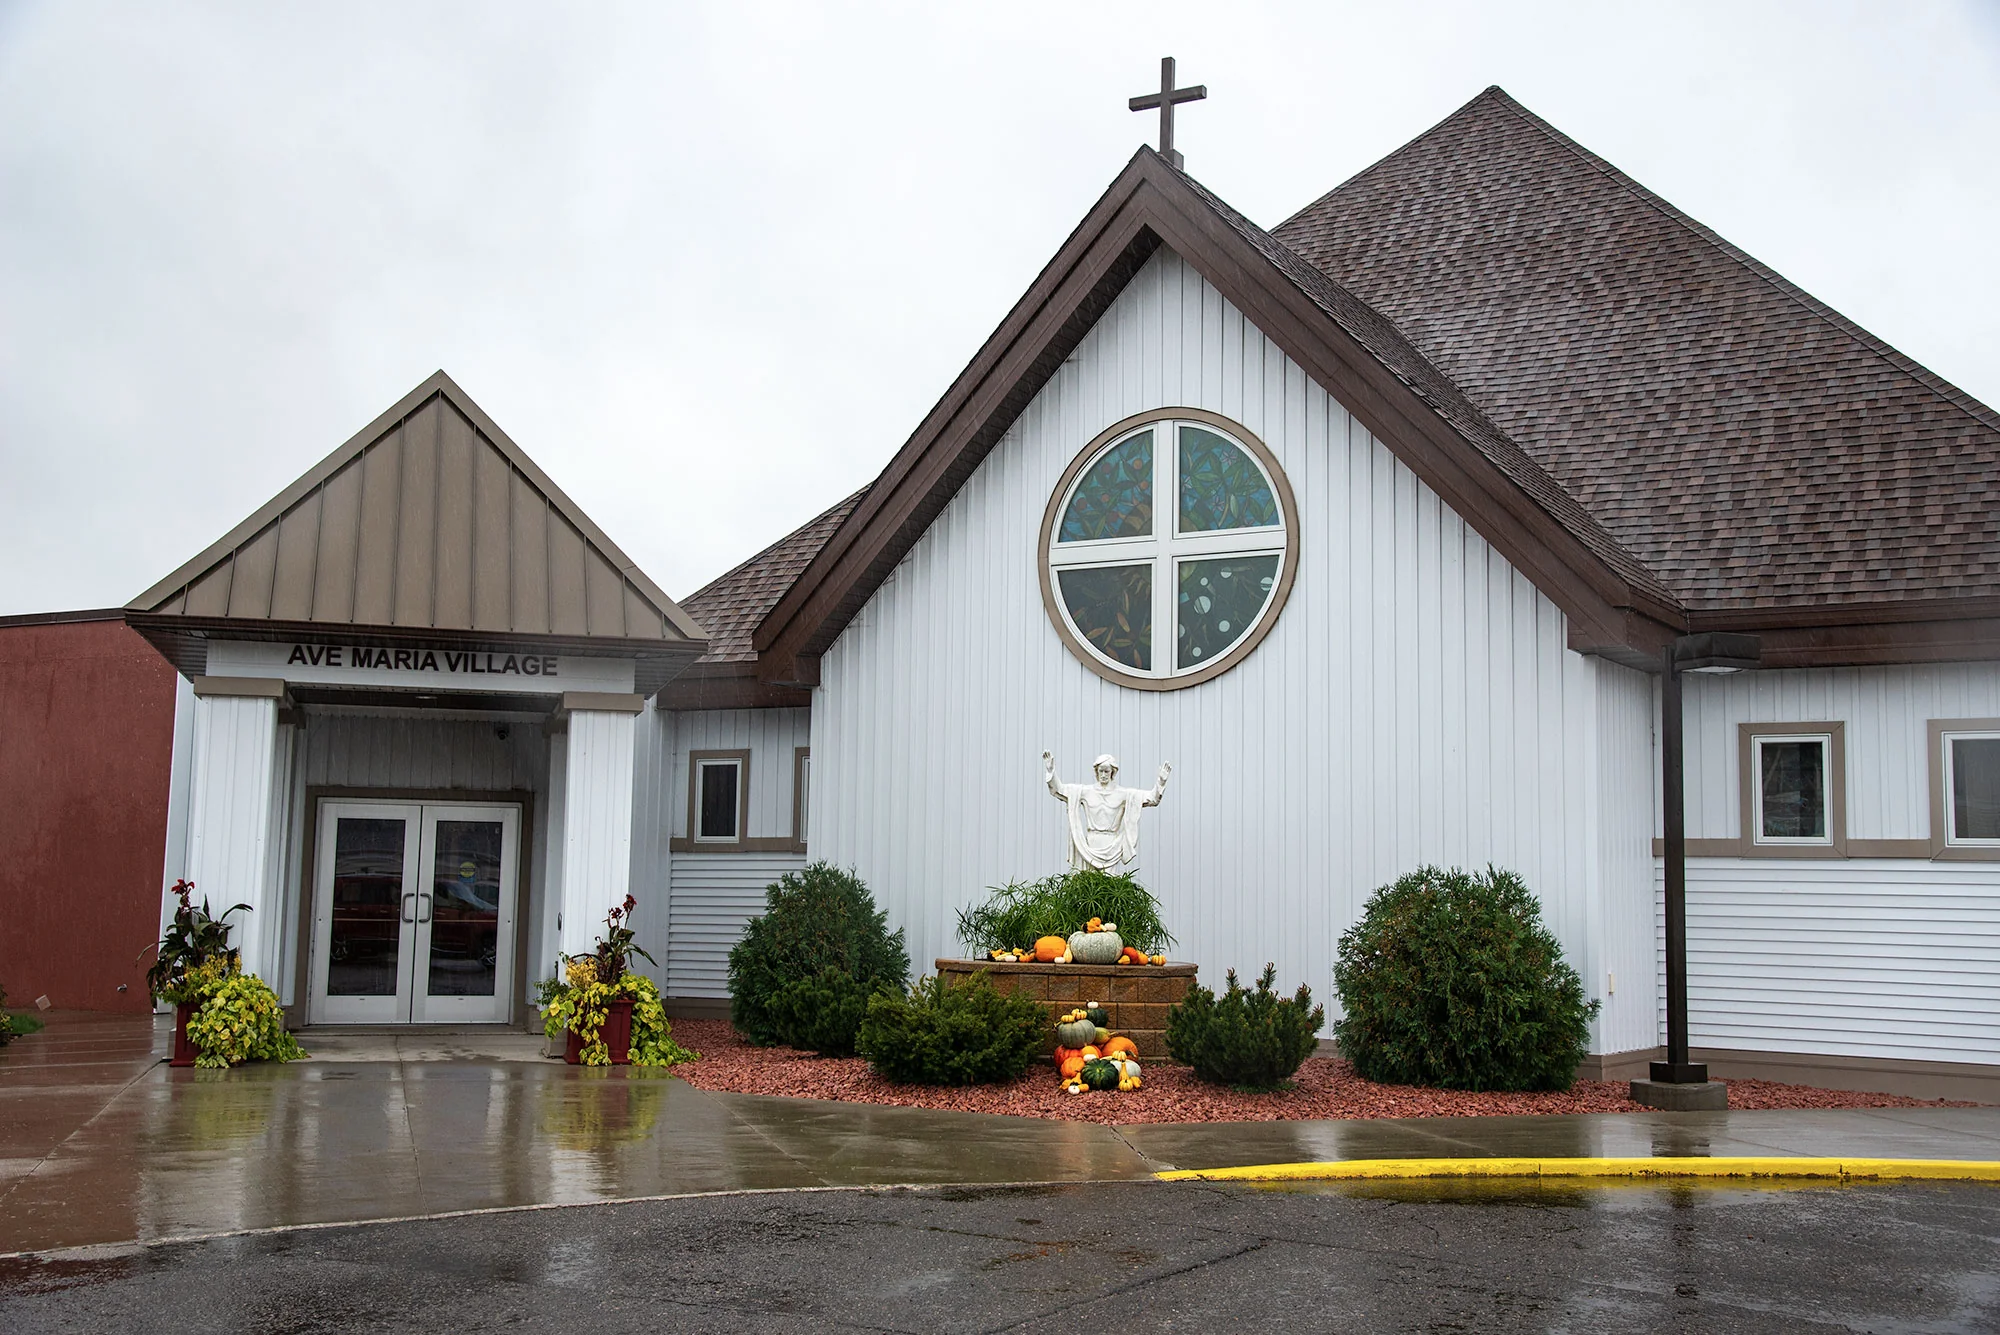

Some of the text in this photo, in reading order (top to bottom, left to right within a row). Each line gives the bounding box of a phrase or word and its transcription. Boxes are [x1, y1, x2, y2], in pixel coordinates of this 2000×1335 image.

[287, 645, 558, 676] AVE MARIA VILLAGE
